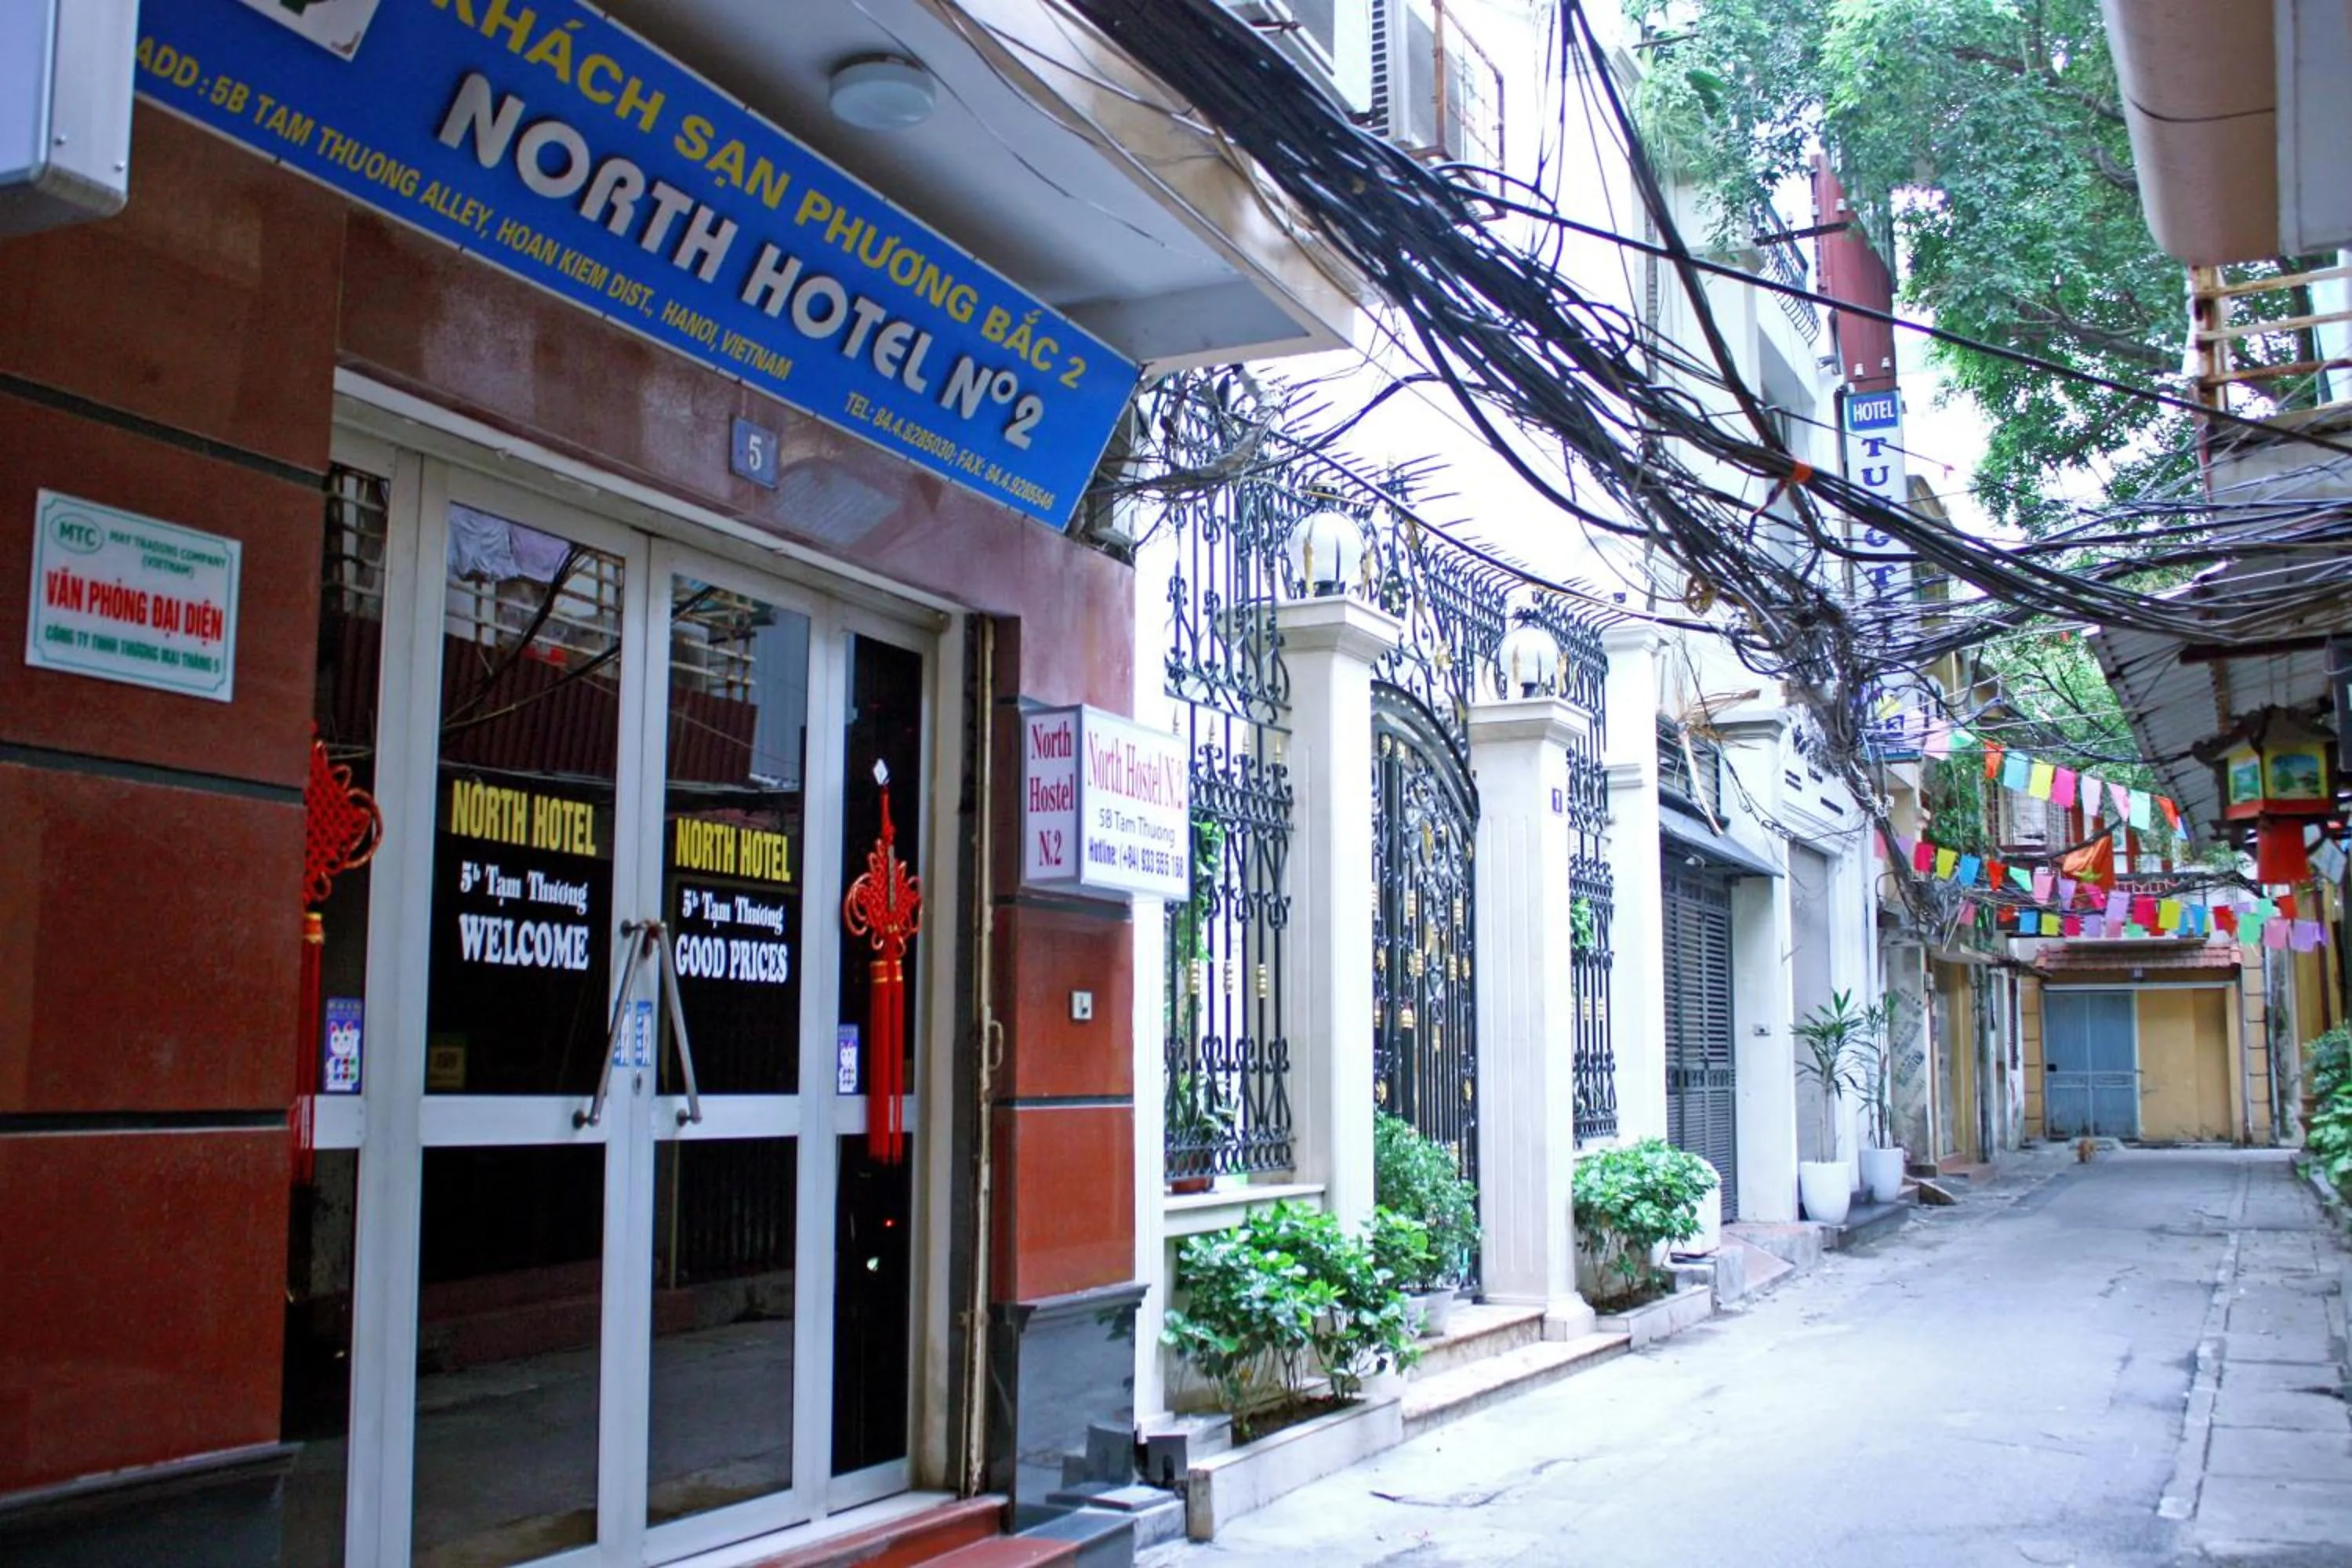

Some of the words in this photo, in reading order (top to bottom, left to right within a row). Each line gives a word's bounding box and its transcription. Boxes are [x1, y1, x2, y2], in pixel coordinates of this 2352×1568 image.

[253, 93, 316, 146] TAM
[317, 125, 420, 197] THUONG
[419, 180, 494, 238] ALLEY,
[496, 217, 560, 266] HOAN
[557, 248, 609, 290] KIEM
[662, 299, 718, 353] HANOI,
[721, 329, 793, 380] VIETNAM
[438, 73, 739, 284] NORTH
[741, 242, 934, 394] HOTEL
[673, 114, 790, 209] SẠN
[794, 188, 978, 323] PHƯƠNG
[981, 305, 1059, 372] BẮC
[1059, 357, 1087, 389] 2
[844, 391, 874, 421] TEL:
[956, 448, 985, 477] FAX:
[1853, 401, 1894, 422] HOTEL
[749, 434, 762, 472] 5
[59, 522, 96, 546] MTC
[180, 549, 226, 568] COMPANY
[46, 567, 83, 612] VĂN
[1032, 721, 1072, 760] North
[1087, 730, 1122, 795] North
[1126, 743, 1162, 806] Hostel
[1029, 774, 1074, 812] Hostel
[452, 780, 528, 845] NORTH
[532, 794, 596, 855] HOTEL
[1098, 808, 1112, 829] 5B
[1114, 811, 1135, 834] Tam
[1137, 816, 1175, 848] Thuong
[676, 817, 735, 874] NORTH
[739, 828, 791, 882] HOTEL
[1039, 830, 1062, 867] N.2
[485, 863, 521, 906] Tạm
[527, 869, 588, 915] Thương
[702, 891, 731, 929] Tạm
[735, 895, 784, 935] Thương
[459, 913, 589, 971] WELCOME
[676, 933, 726, 978] GOOD
[729, 939, 788, 984] PRICES
